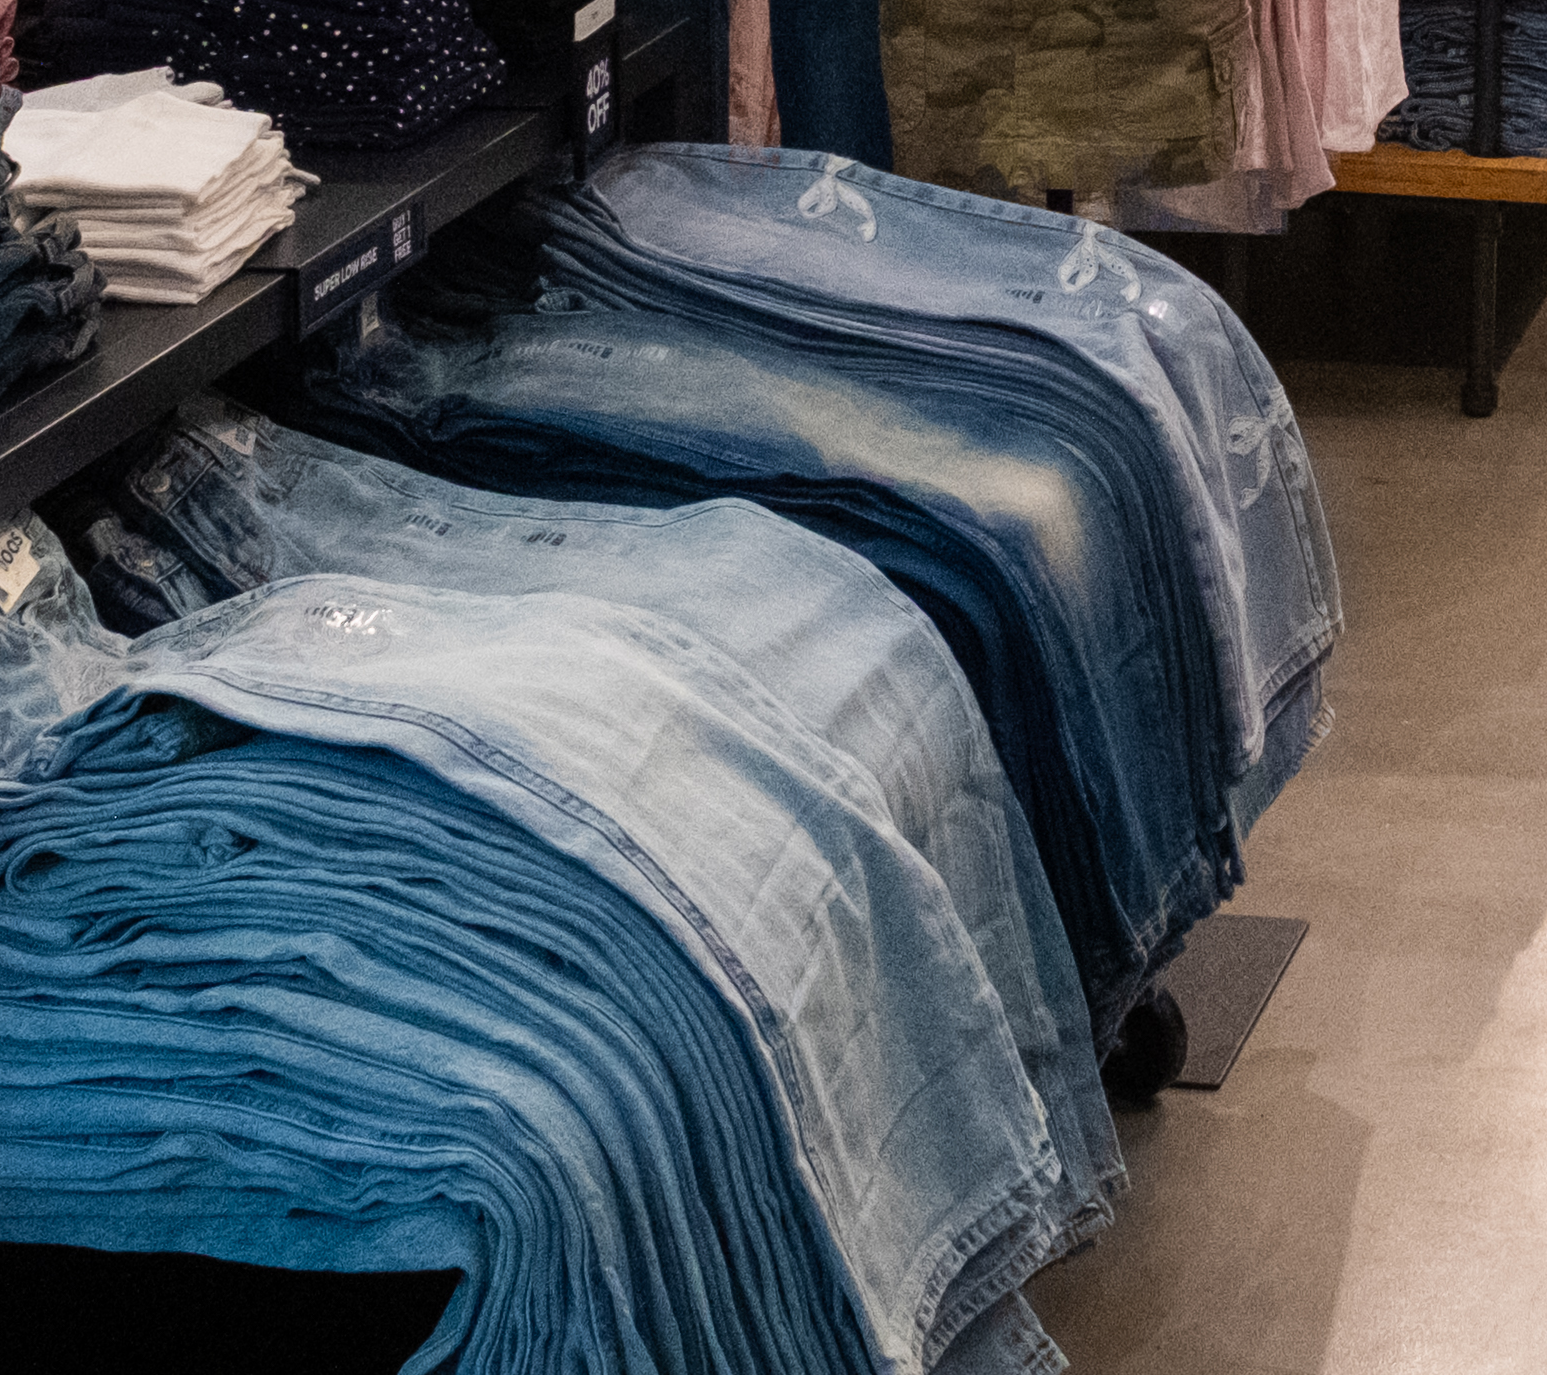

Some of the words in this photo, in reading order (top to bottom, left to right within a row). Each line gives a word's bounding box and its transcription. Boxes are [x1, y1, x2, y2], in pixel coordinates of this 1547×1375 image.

[586, 57, 610, 99] 40%
[587, 91, 610, 134] OFF
[393, 227, 406, 247] GET
[394, 240, 411, 263] FREE
[314, 271, 341, 301] SUPER
[341, 258, 360, 283] LOW
[360, 246, 378, 270] RISE
